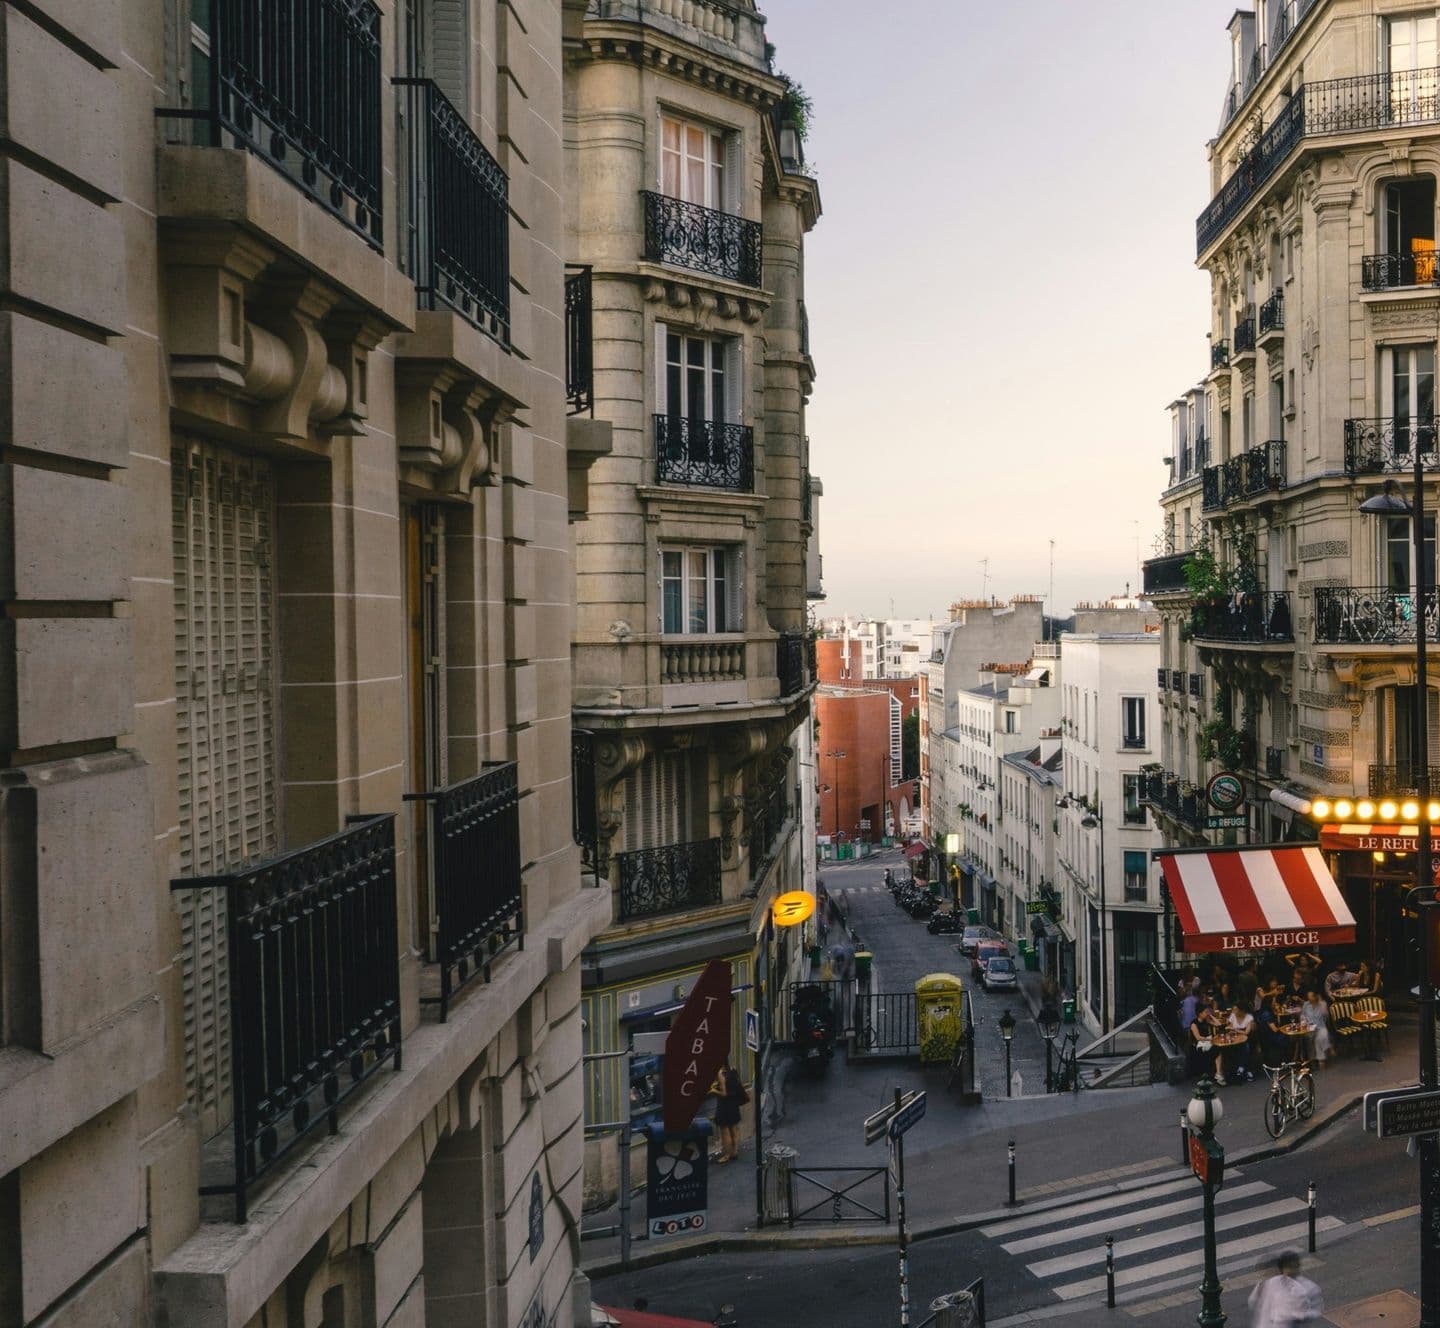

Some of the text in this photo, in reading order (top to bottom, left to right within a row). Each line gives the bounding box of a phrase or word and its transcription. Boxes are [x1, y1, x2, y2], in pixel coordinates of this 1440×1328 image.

[1219, 817, 1247, 827] REFUGE
[1358, 837, 1378, 849] LE
[1222, 931, 1319, 950] LE REFUGE
[680, 996, 718, 1097] TABAC
[653, 1214, 704, 1235] LOTO
